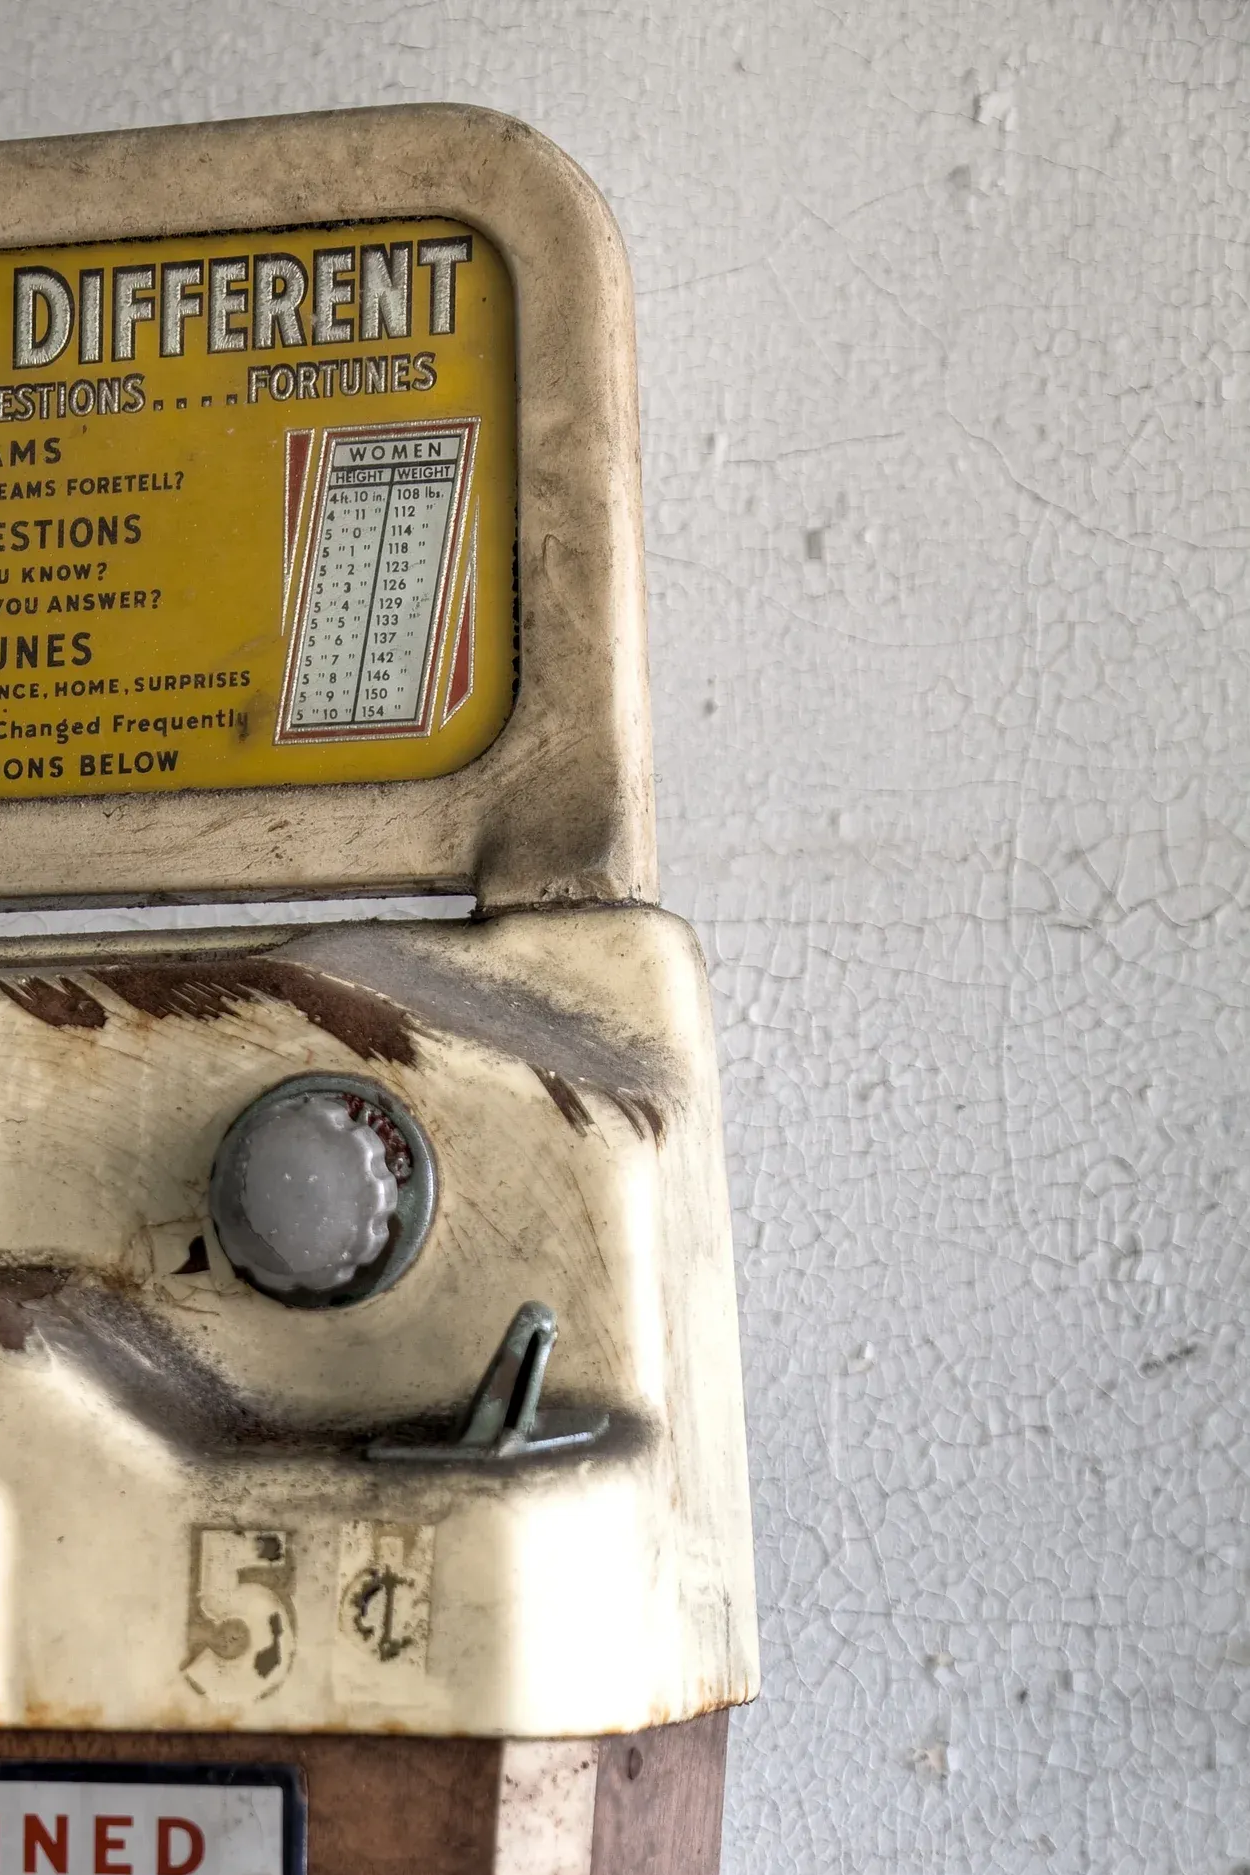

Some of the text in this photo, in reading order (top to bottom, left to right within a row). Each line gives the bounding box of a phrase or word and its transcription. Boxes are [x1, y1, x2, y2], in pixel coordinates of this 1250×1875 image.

[12, 235, 473, 370] DIFFERENT
[248, 352, 438, 404] FORTUNES
[349, 442, 441, 462] WOMEN
[335, 465, 451, 484] HEIGHT WEIGHT
[67, 471, 184, 496] FORETELL?
[329, 493, 339, 504] 4
[354, 490, 368, 502] 10
[397, 488, 420, 500] 108
[326, 505, 415, 522] 4 11 112
[325, 524, 412, 541] 5 0 114
[322, 542, 408, 558] 5 1 118
[22, 562, 107, 583] KNOW?
[319, 561, 409, 577] 5 2 123
[316, 578, 406, 595] 5 3 126
[47, 589, 161, 613] ANSWER?
[314, 597, 402, 613] 5 4 129
[310, 614, 398, 630] 5 5 133
[308, 632, 397, 647] 5 6 137
[305, 651, 394, 667] 5 7 142
[134, 670, 250, 692] SURPRISES
[302, 670, 390, 685] 5 8 146
[299, 688, 388, 703] 5 9 150
[296, 705, 384, 721] 5 10 154
[80, 750, 179, 776] BELOW
